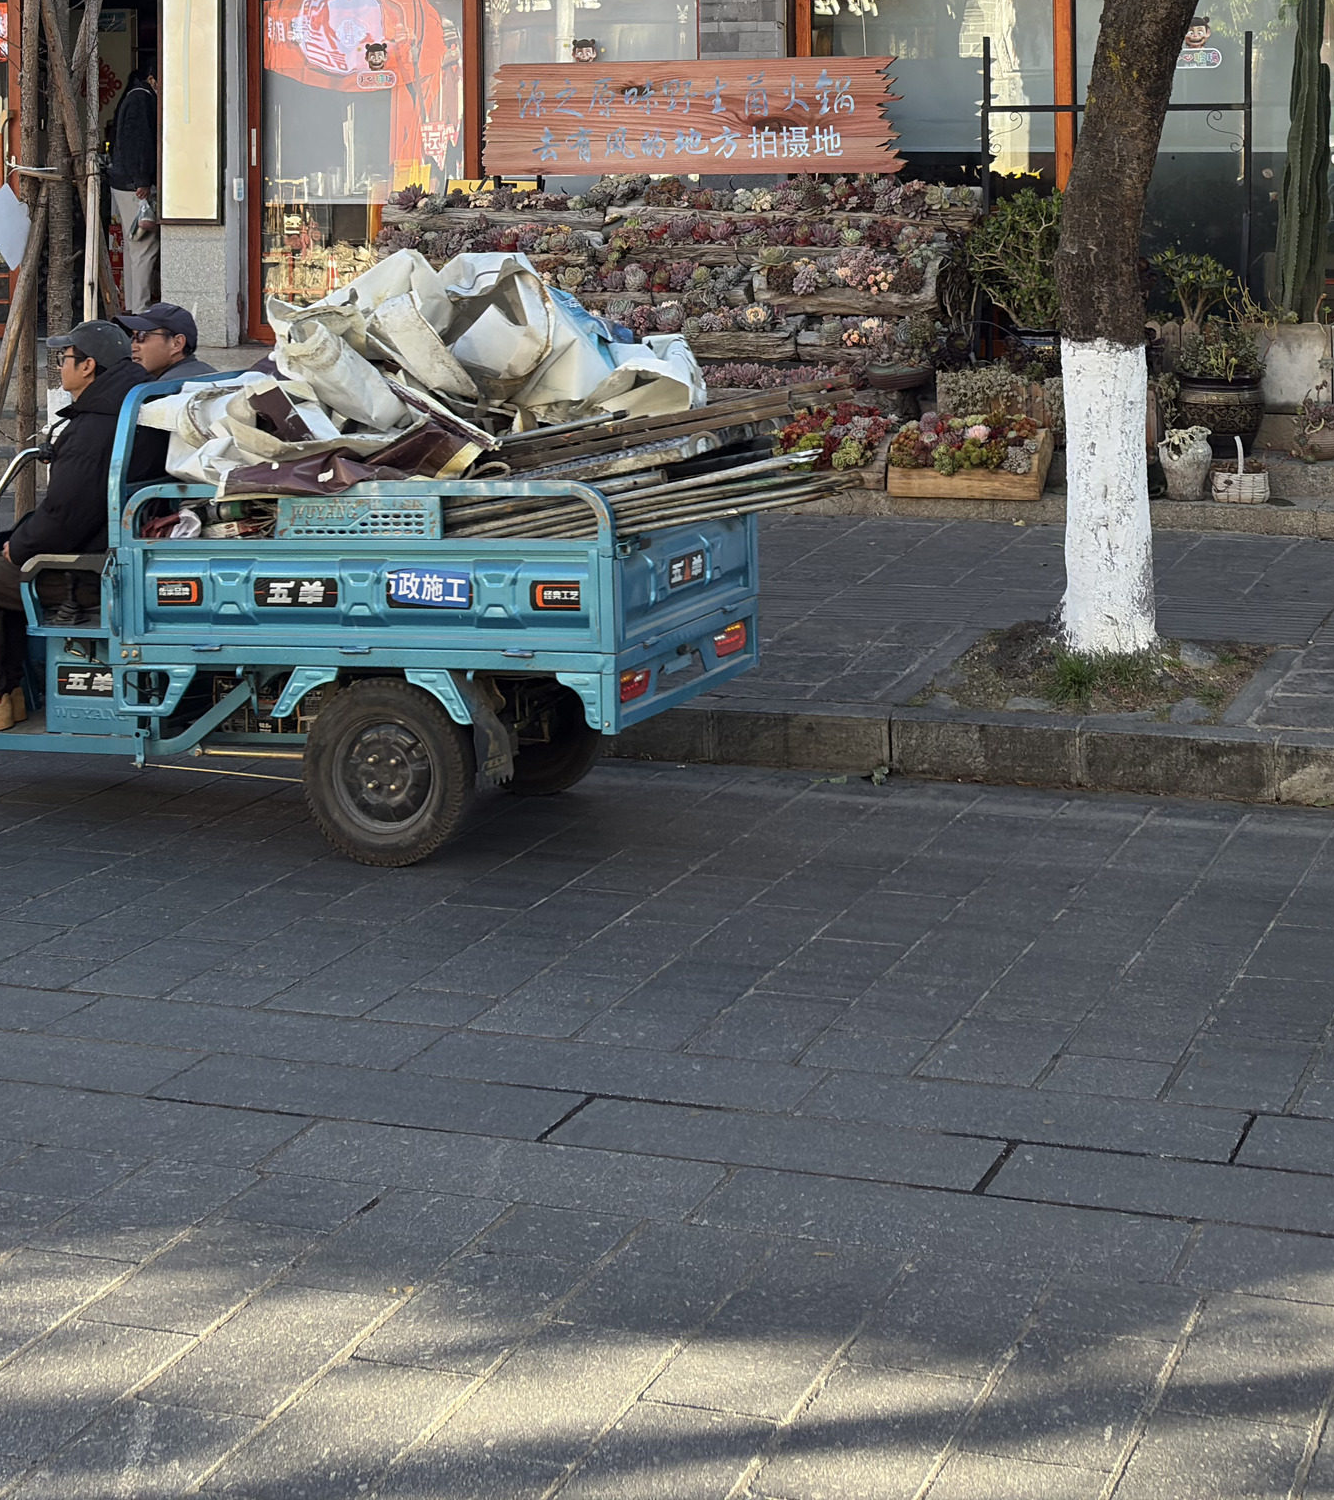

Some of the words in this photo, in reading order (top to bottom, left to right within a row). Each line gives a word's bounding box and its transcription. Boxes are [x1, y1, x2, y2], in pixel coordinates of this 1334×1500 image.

[515, 68, 856, 120] 源之原味野生菌火锅
[532, 124, 843, 163] 去有风的地方拍摄地
[291, 502, 358, 520] WUYANG
[671, 554, 703, 584] 五羊
[267, 581, 326, 605] 五羊
[542, 589, 580, 601] 经典工艺
[66, 671, 114, 691] 五羊
